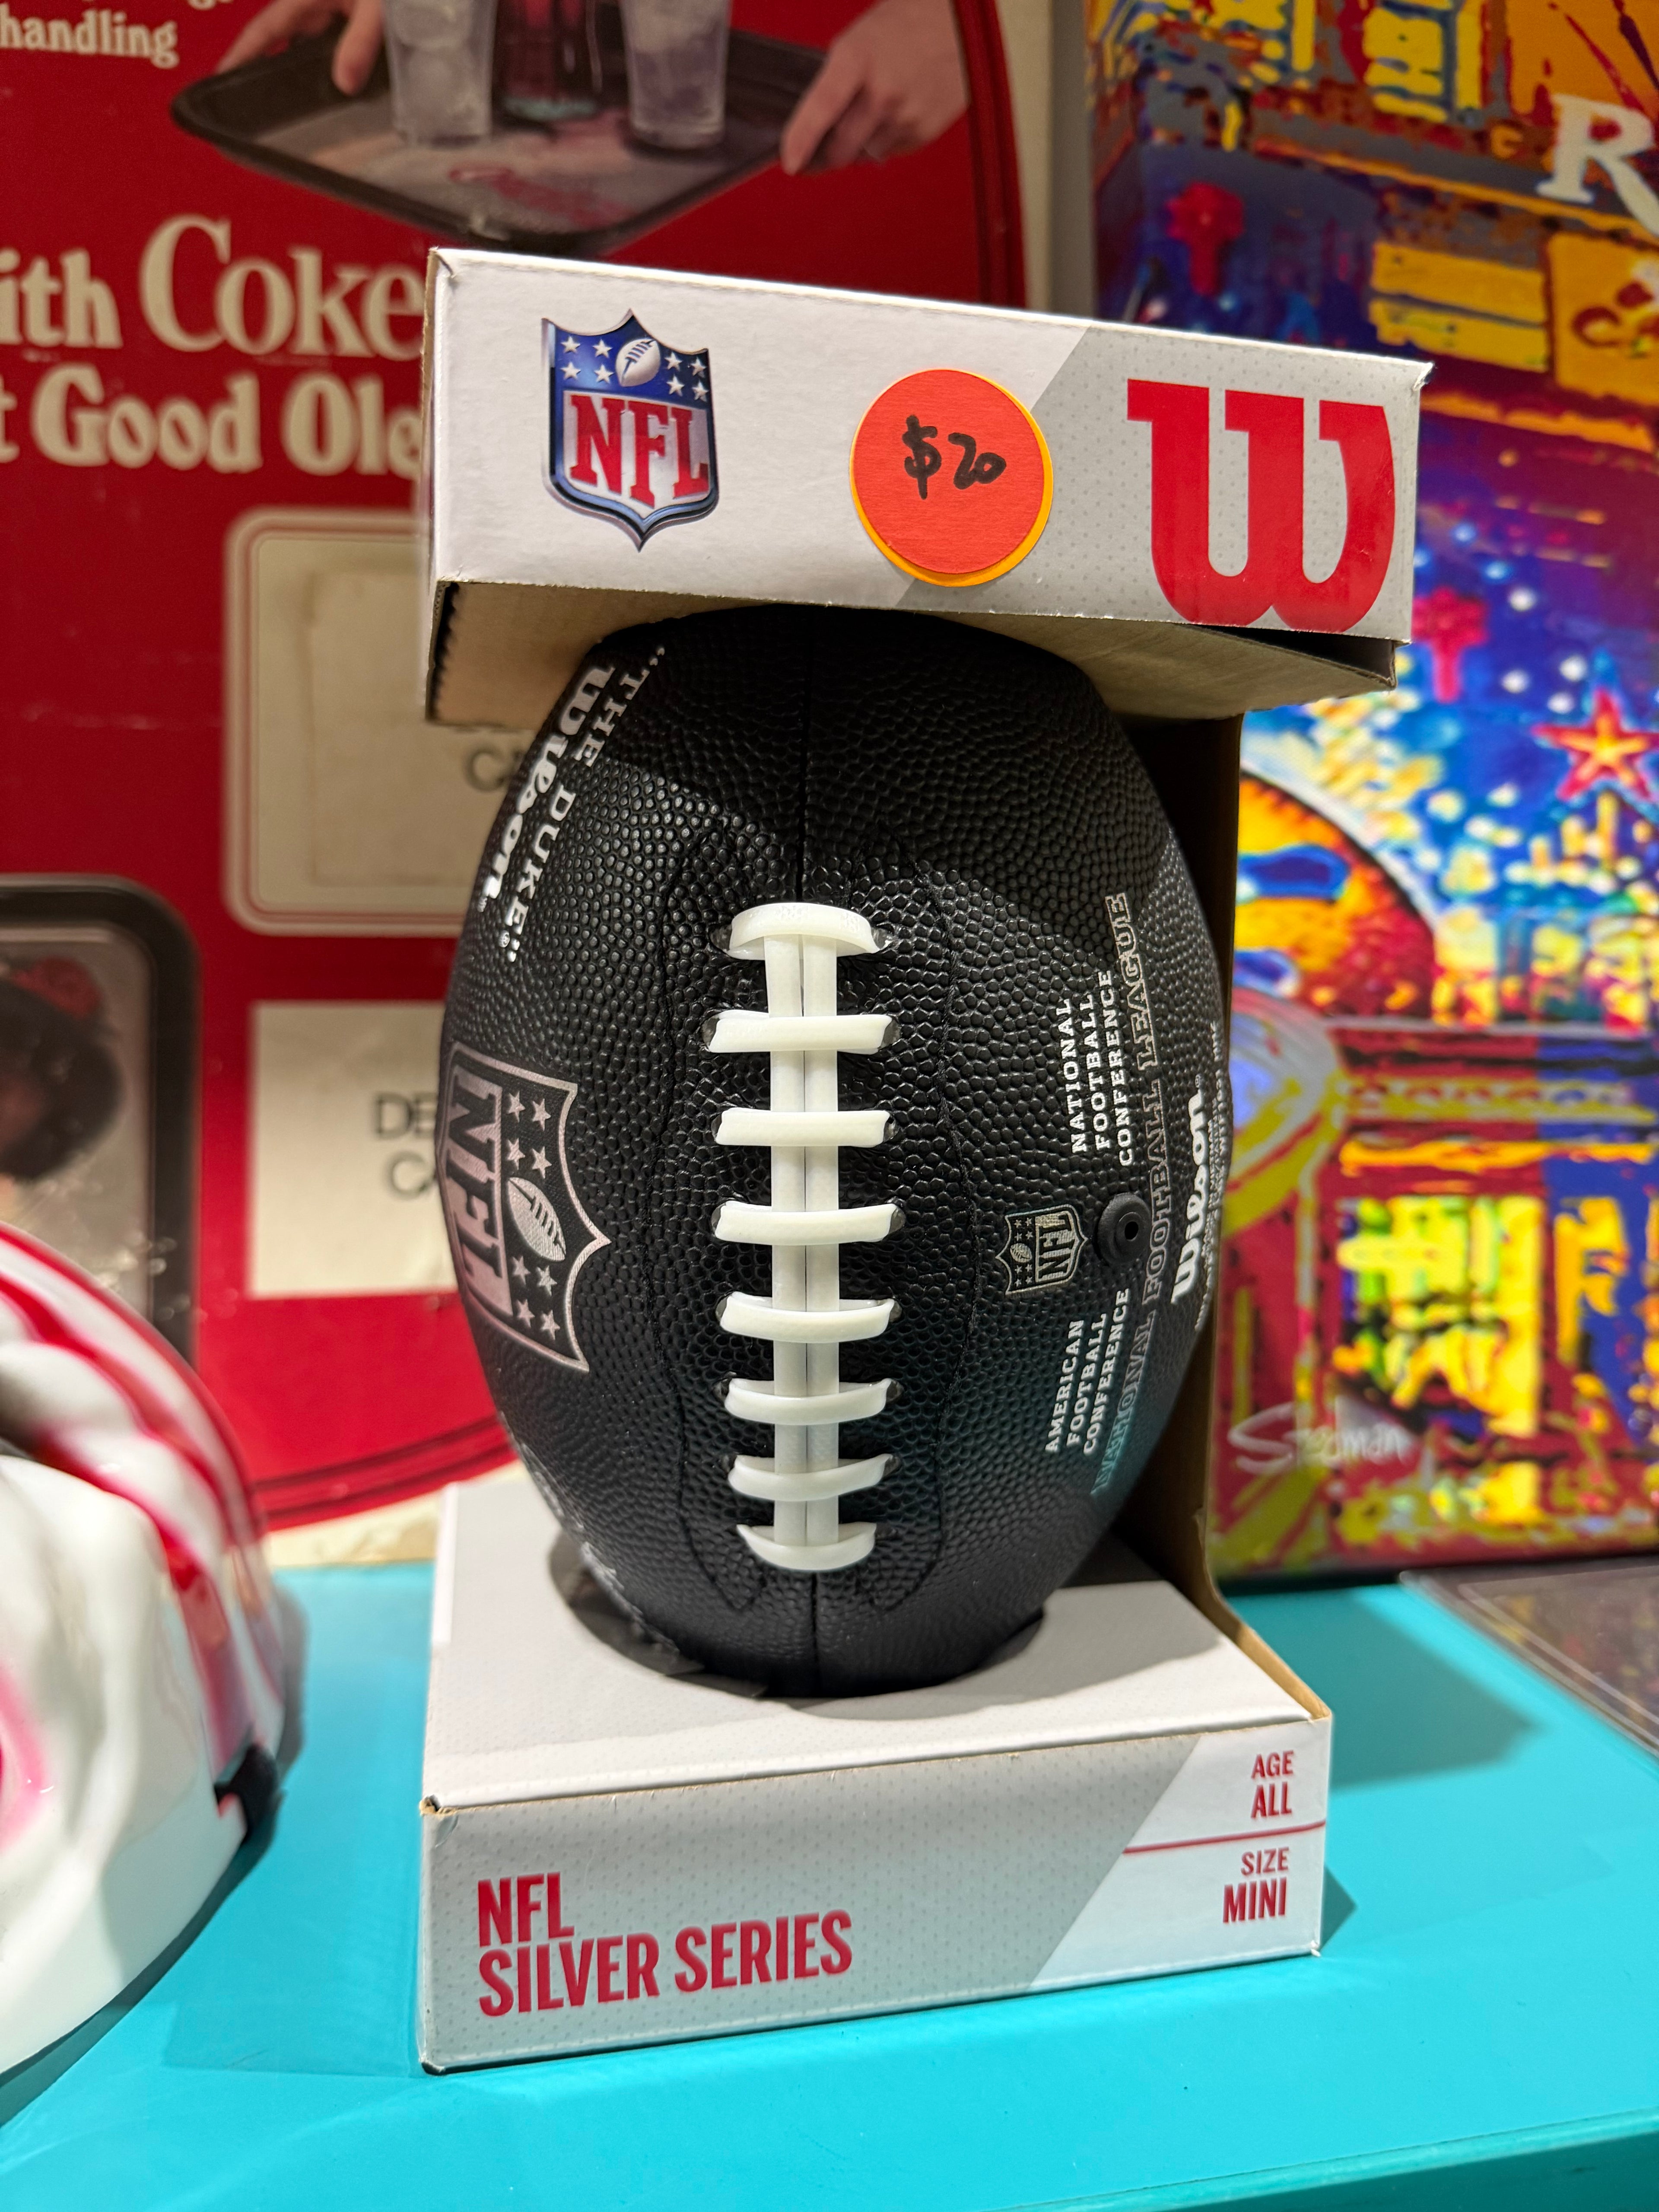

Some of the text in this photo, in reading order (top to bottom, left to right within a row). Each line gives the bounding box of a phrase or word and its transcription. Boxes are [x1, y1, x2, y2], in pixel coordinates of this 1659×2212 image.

[0, 3, 179, 69] handling
[140, 214, 425, 362] Coke
[30, 362, 263, 474] Good
[281, 371, 423, 480] Ole
[569, 393, 710, 509] NFL
[902, 414, 1007, 500] $20
[1127, 378, 1395, 633] W
[372, 1091, 436, 1140] DE
[1056, 998, 1088, 1154] NATIONAL
[1080, 994, 1110, 1150] FOOTBALL
[1099, 970, 1133, 1167] CONFERENCE
[446, 1074, 503, 1279] NFL
[1090, 892, 1172, 1497] NATIONAL FOOTBALL LEAGUE
[1170, 1089, 1208, 1304] Wilson
[1037, 1213, 1074, 1281] NFL
[1045, 1319, 1084, 1452] AMERICAN
[1066, 1313, 1106, 1447] FOOTBALL
[1083, 1287, 1129, 1456] CONFERENCE
[1250, 1781, 1292, 1819] ALL
[1251, 1750, 1294, 1779] AGE
[478, 1872, 575, 1947] NFL
[1222, 1876, 1287, 1923] MINI
[1240, 1846, 1289, 1876] SIZE
[478, 1909, 852, 2017] SILVER SERIES
